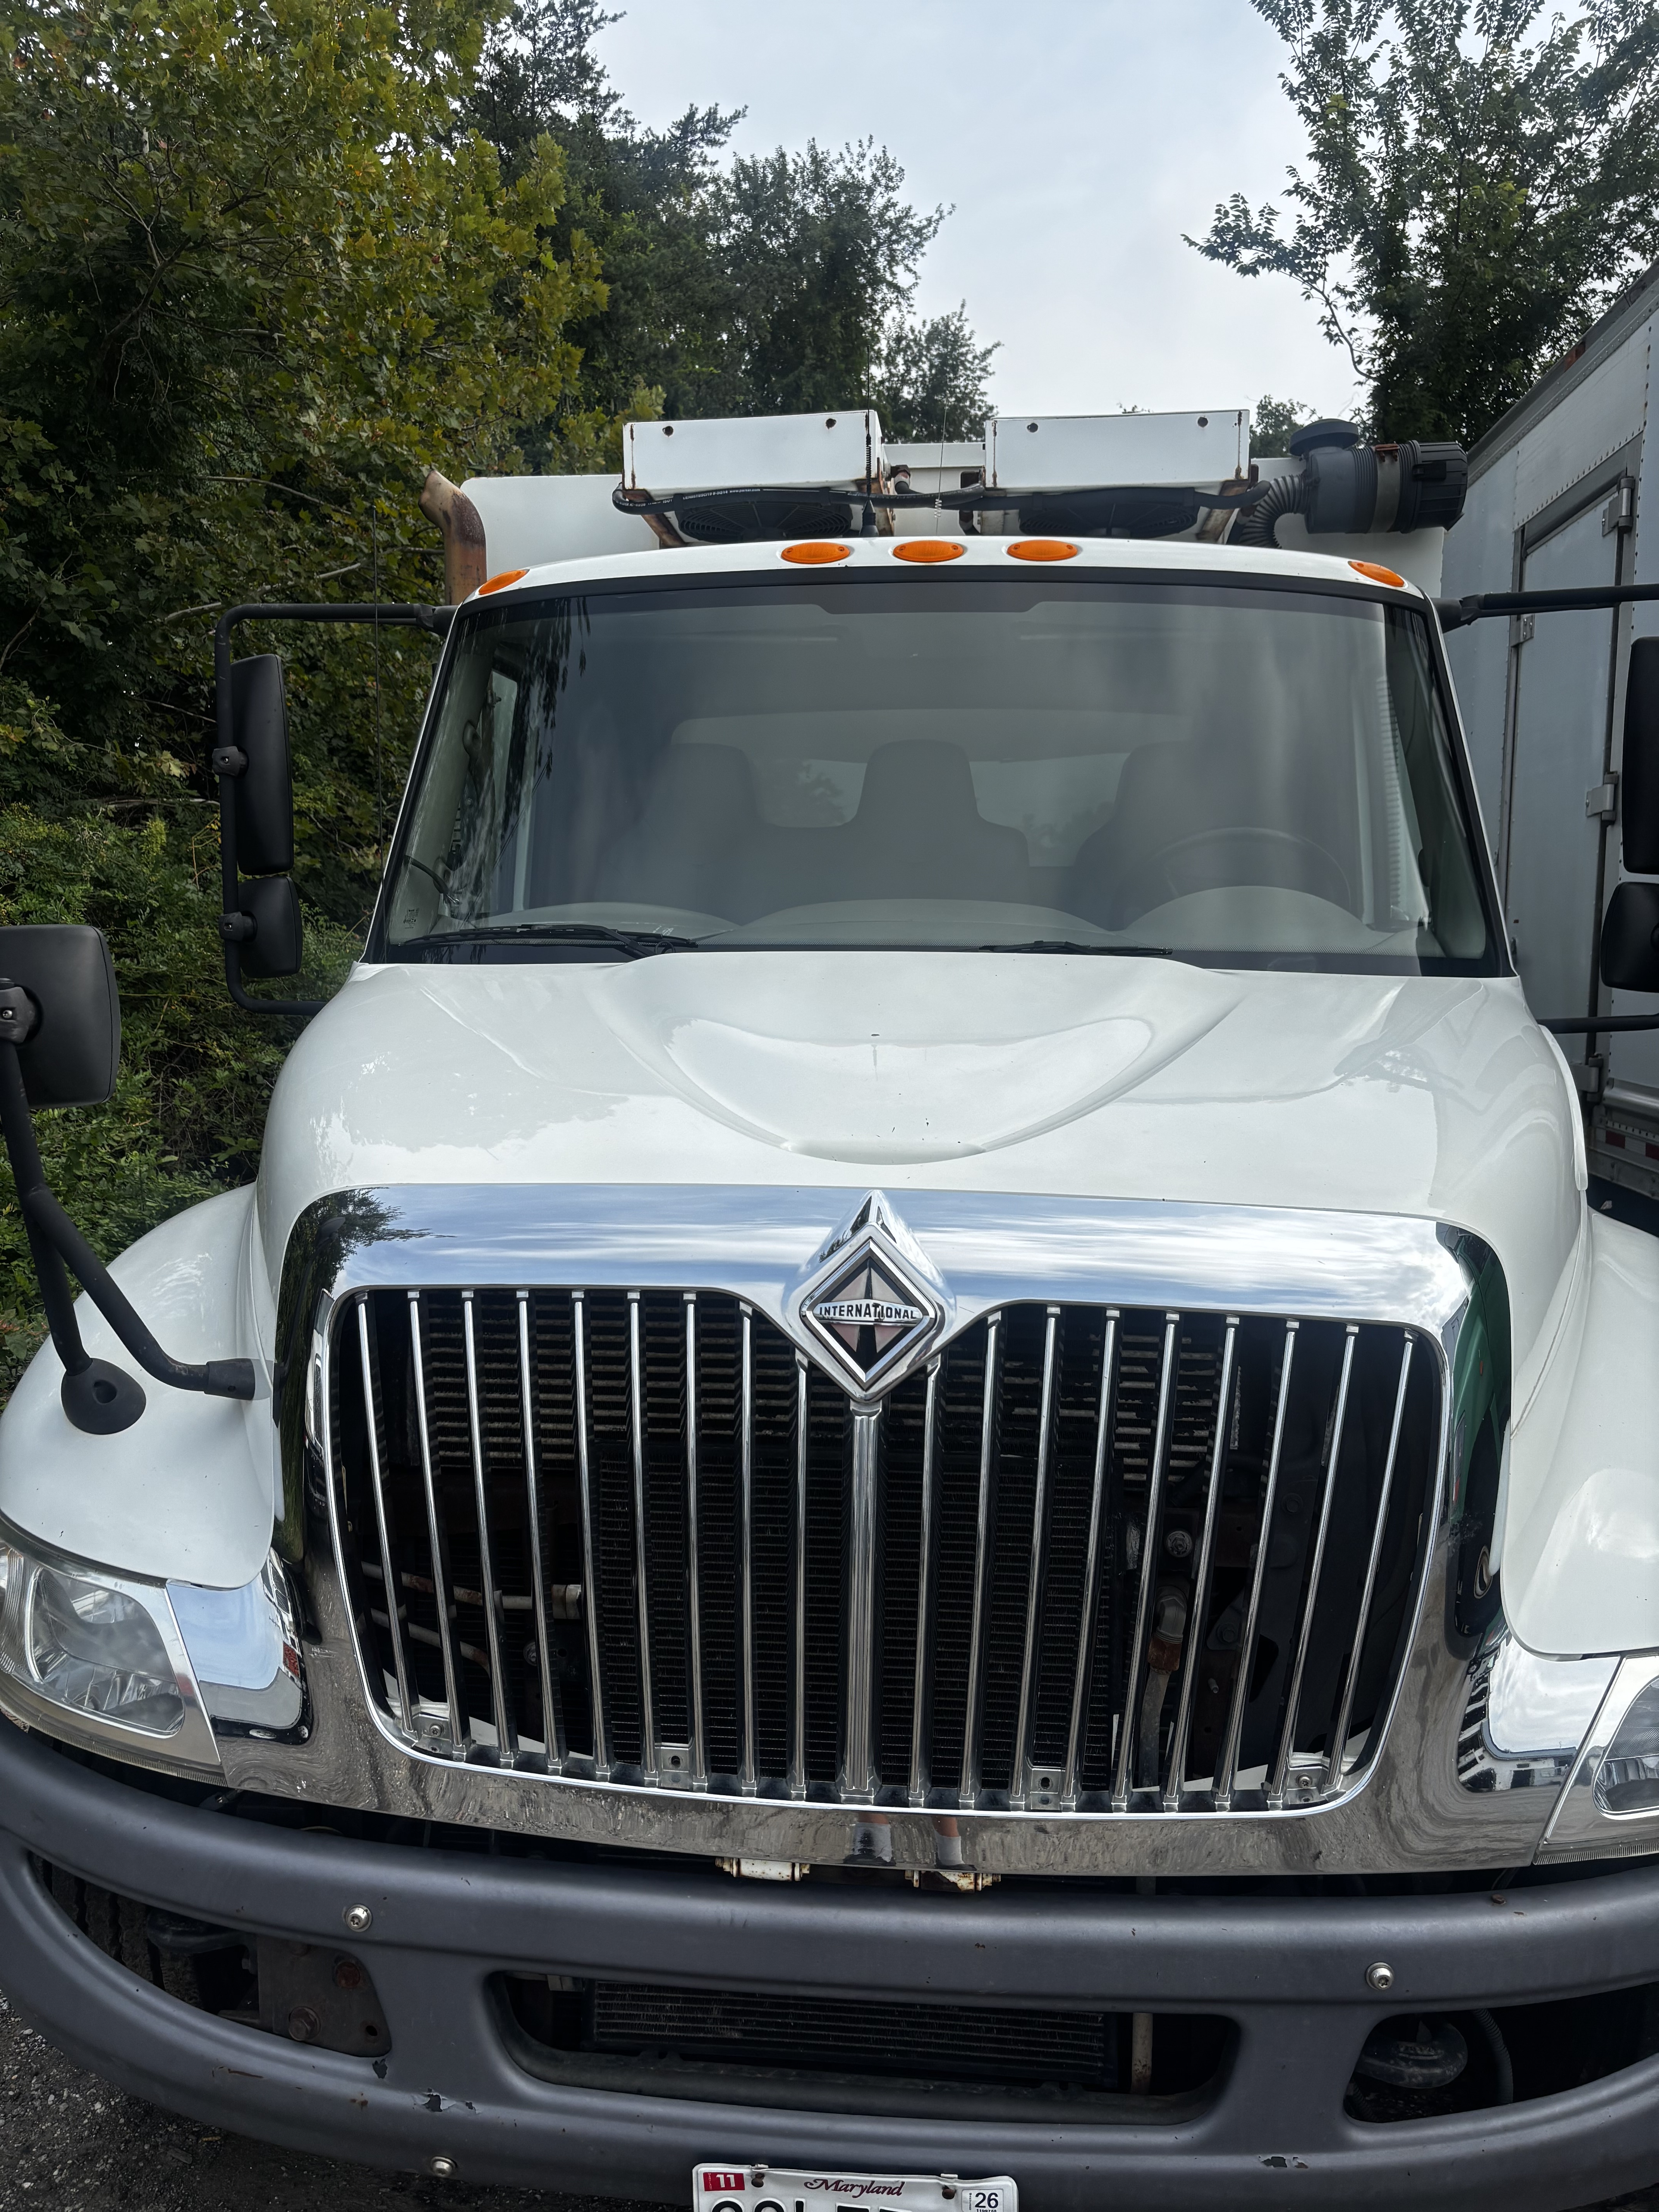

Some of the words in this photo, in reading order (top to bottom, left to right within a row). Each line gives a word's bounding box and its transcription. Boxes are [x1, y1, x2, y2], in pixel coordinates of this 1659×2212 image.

[819, 1303, 917, 1319] INTERNATIONAL
[716, 2174, 735, 2188] 11
[804, 2178, 905, 2198] Maryland
[975, 2192, 998, 2209] 26
